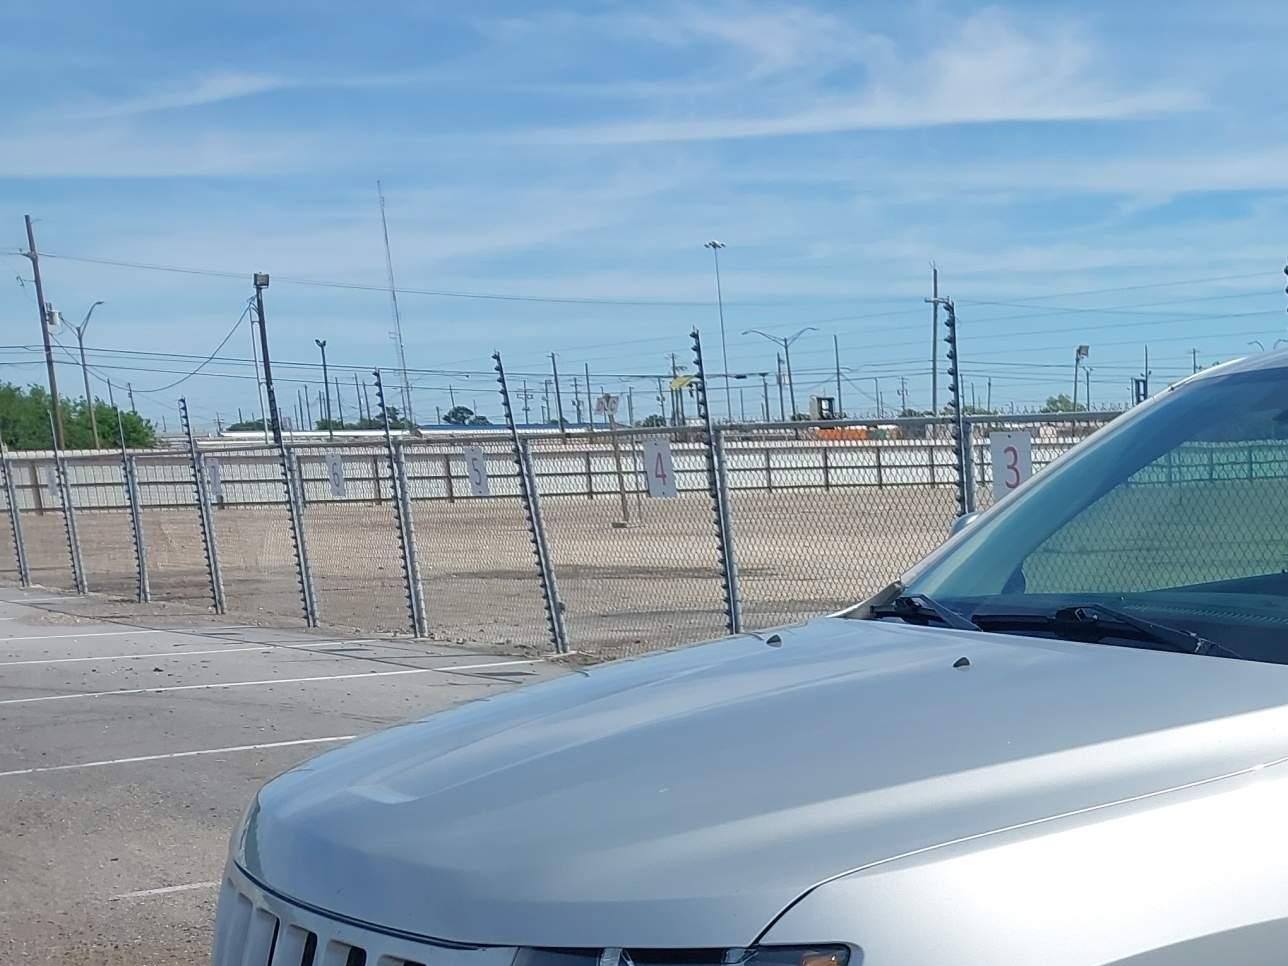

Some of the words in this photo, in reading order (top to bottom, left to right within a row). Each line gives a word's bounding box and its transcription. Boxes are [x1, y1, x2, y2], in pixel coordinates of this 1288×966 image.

[471, 457, 482, 486] 5
[655, 451, 667, 485] 4
[1003, 446, 1020, 489] 3
